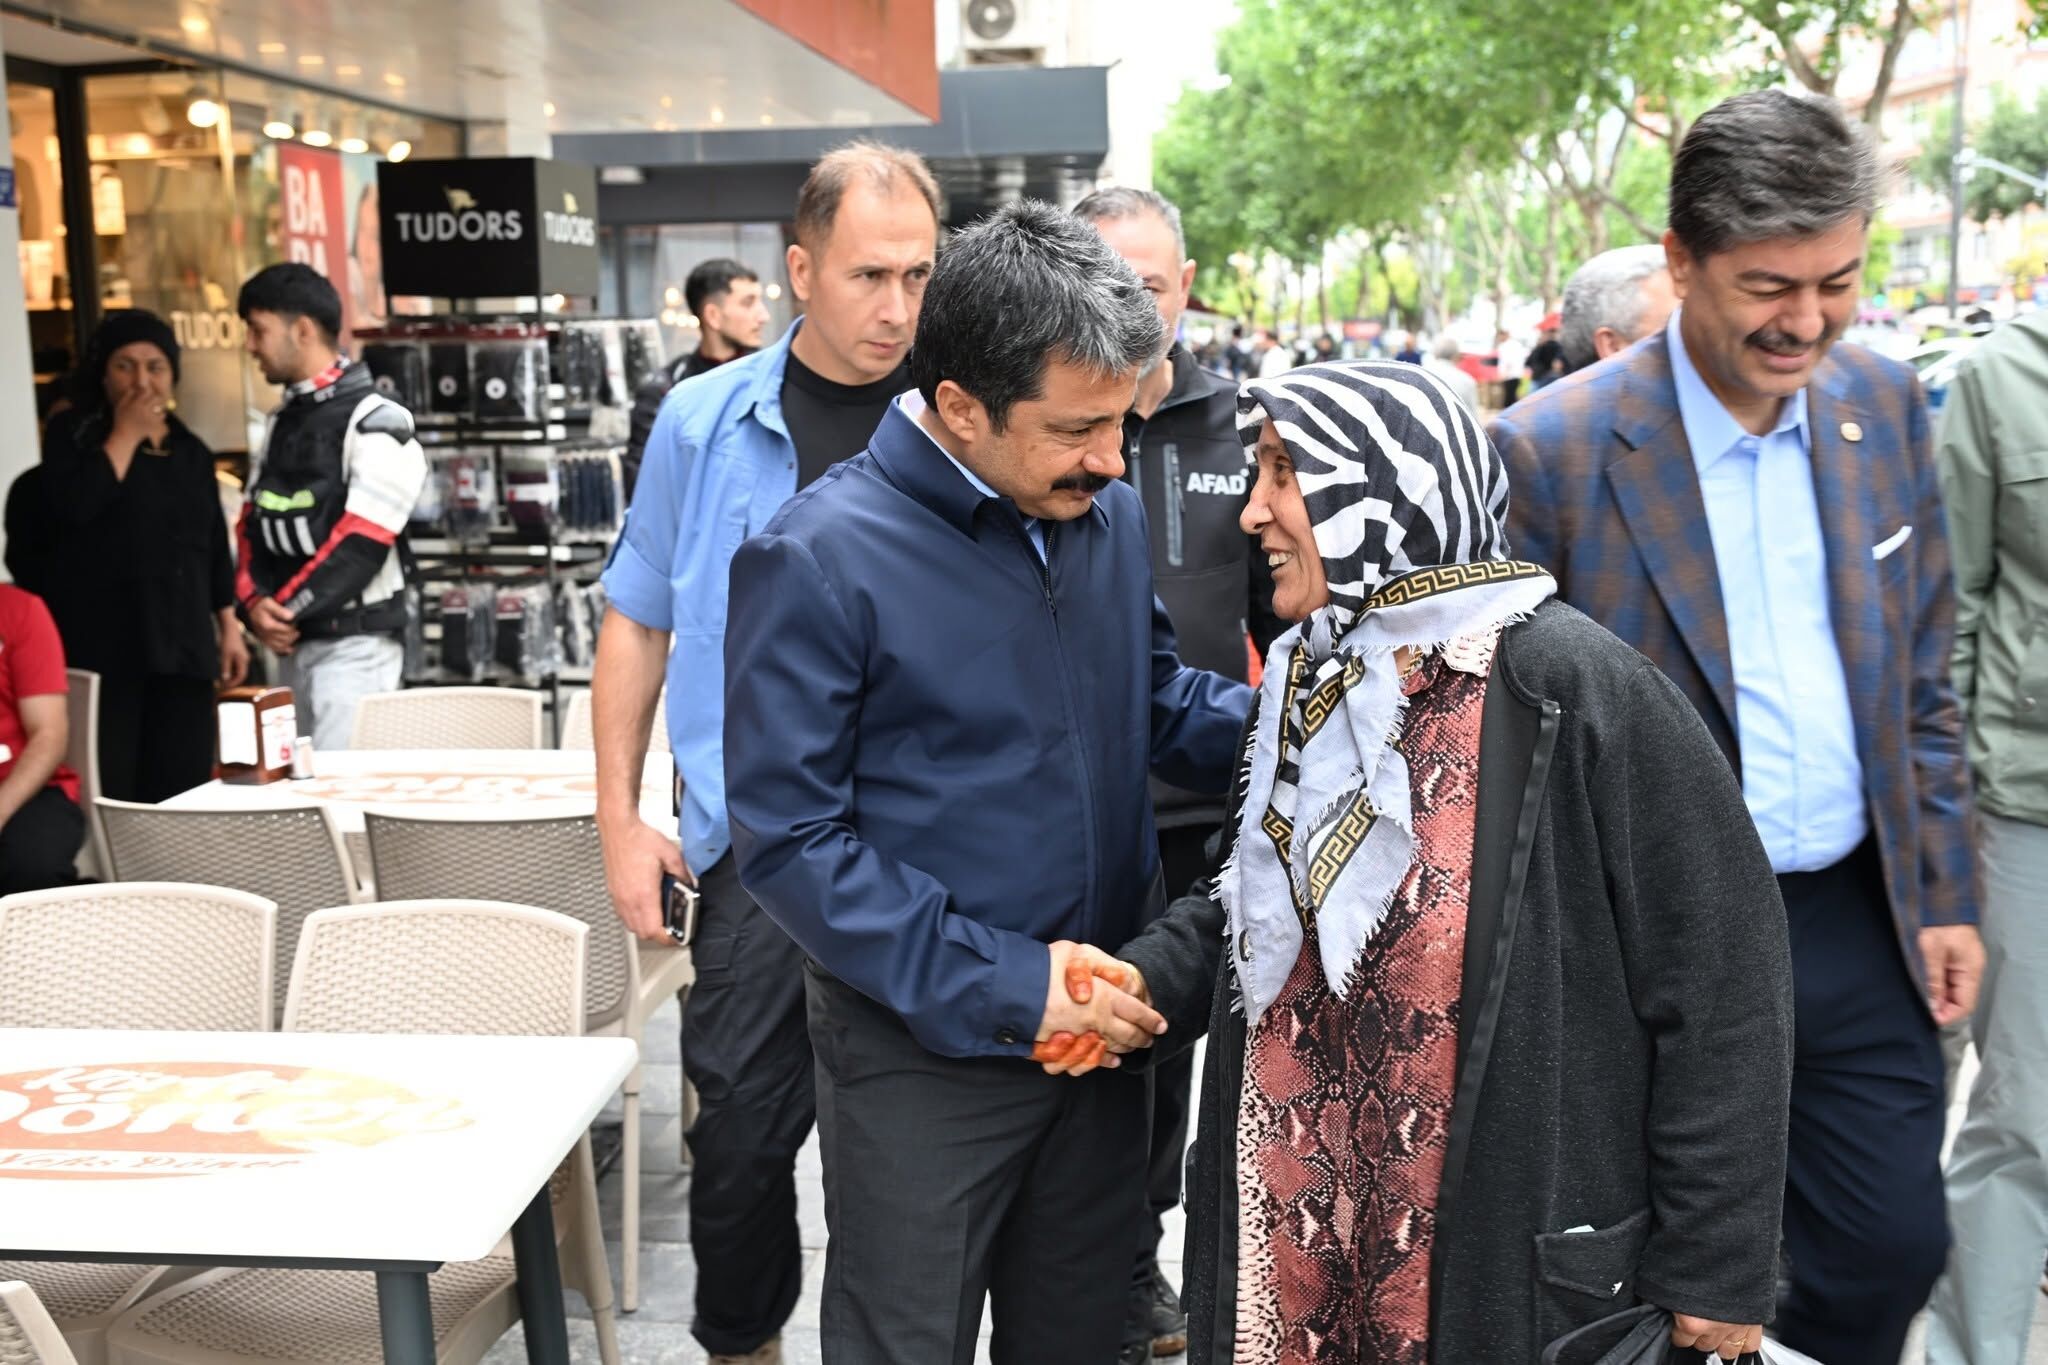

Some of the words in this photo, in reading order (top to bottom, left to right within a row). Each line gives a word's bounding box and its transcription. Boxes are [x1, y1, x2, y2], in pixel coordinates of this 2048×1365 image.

[284, 165, 328, 236] BA
[395, 210, 523, 242] TUDORS
[543, 210, 596, 247] TUDORS
[1186, 471, 1247, 496] AFAD
